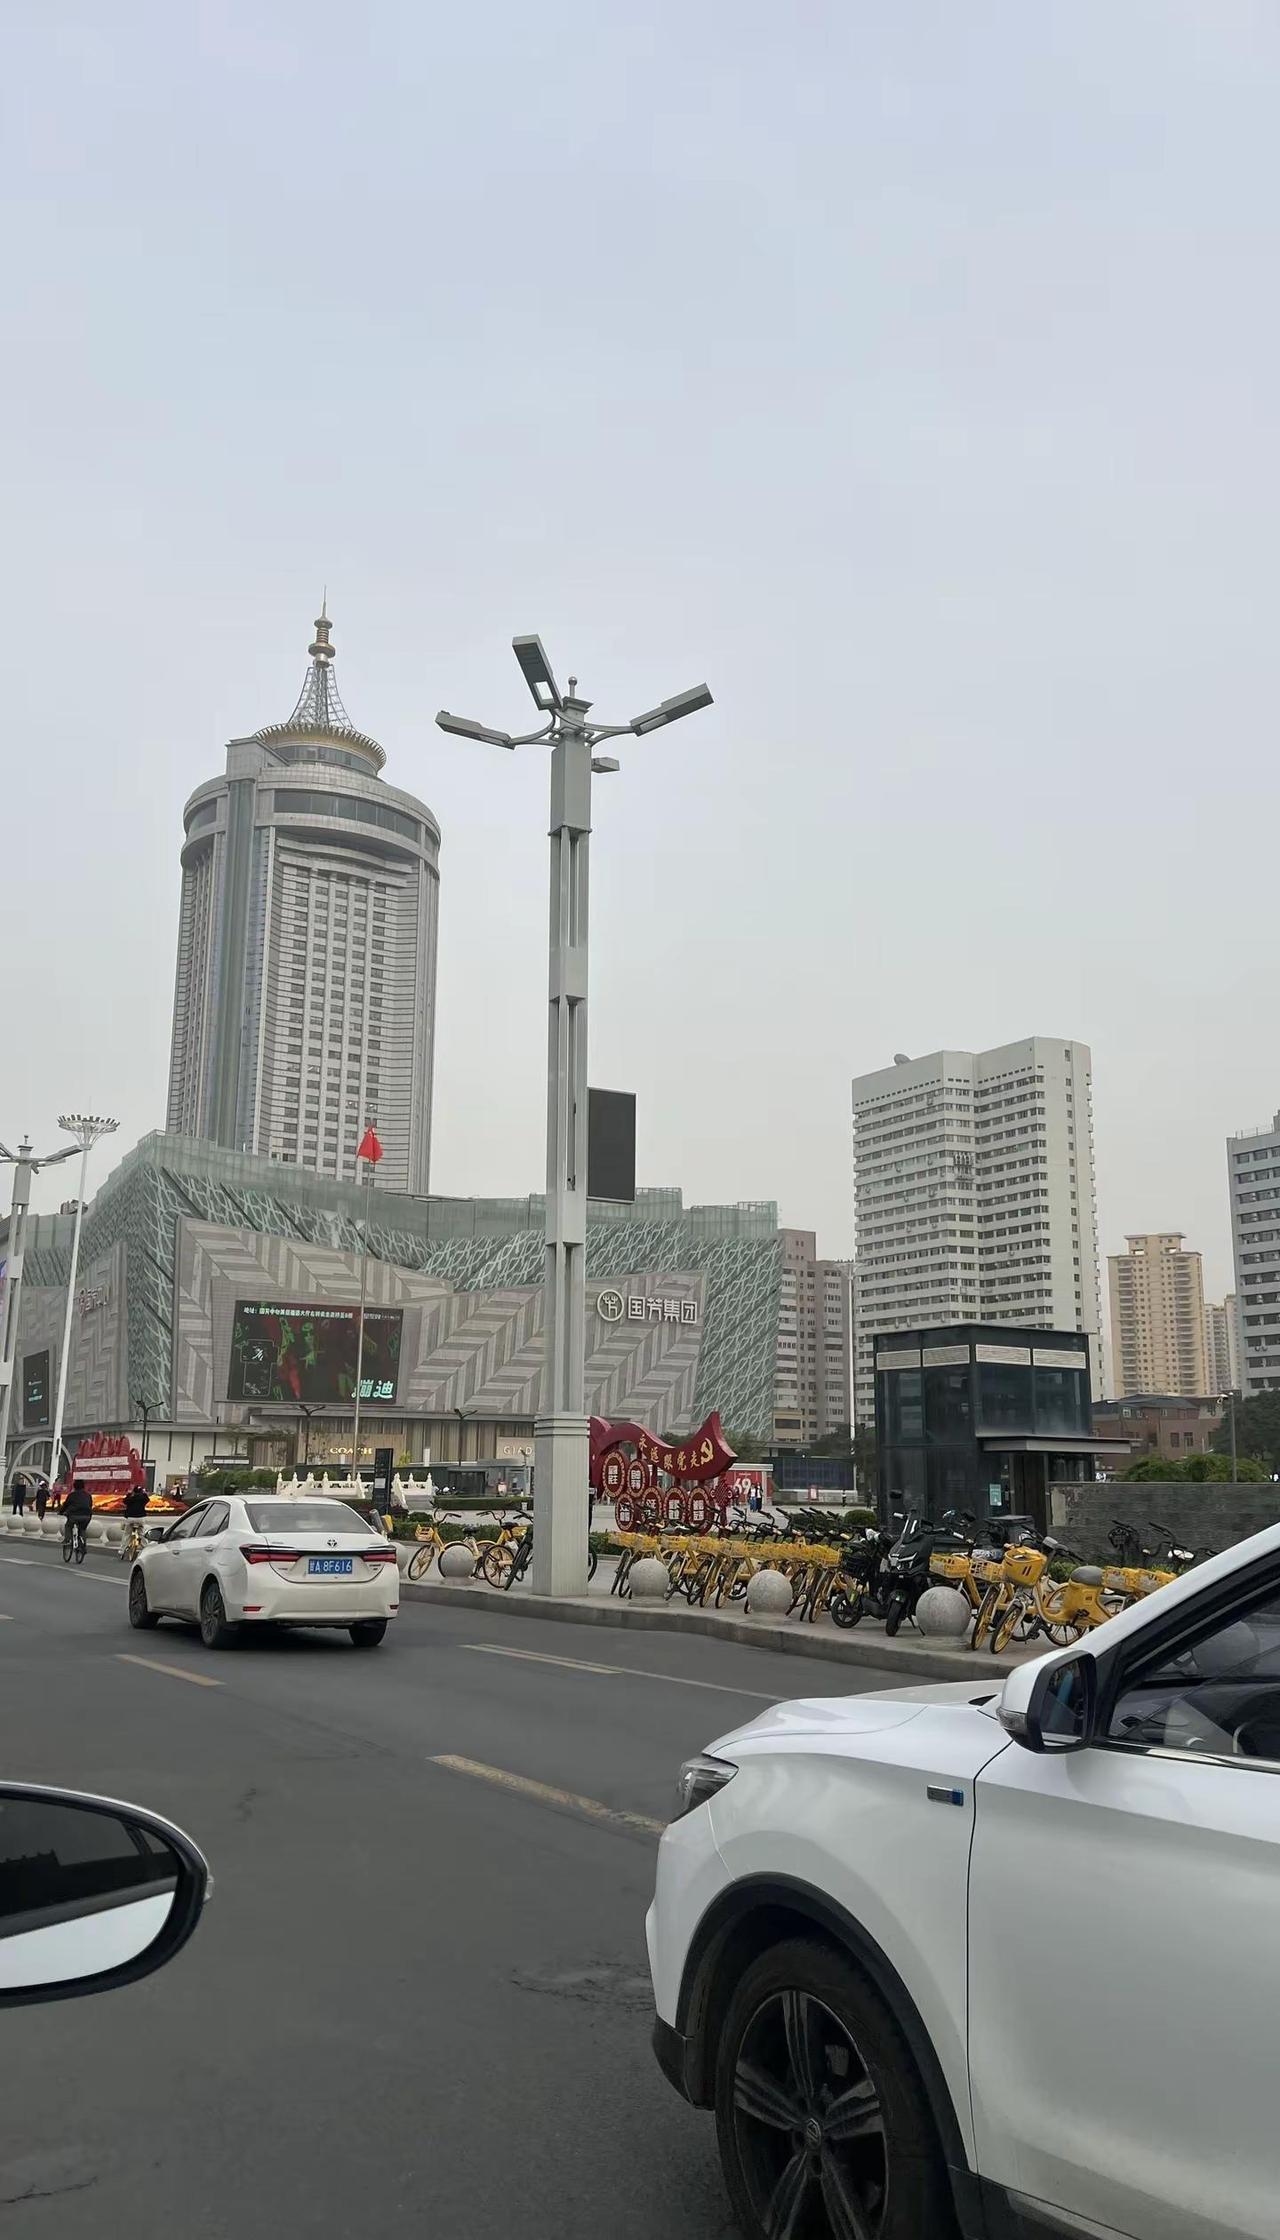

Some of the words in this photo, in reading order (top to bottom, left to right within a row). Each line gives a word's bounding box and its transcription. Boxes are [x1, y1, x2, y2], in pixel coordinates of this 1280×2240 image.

[628, 1295, 697, 1324] 国芳集团
[639, 1434, 700, 1471] 永远跟党走
